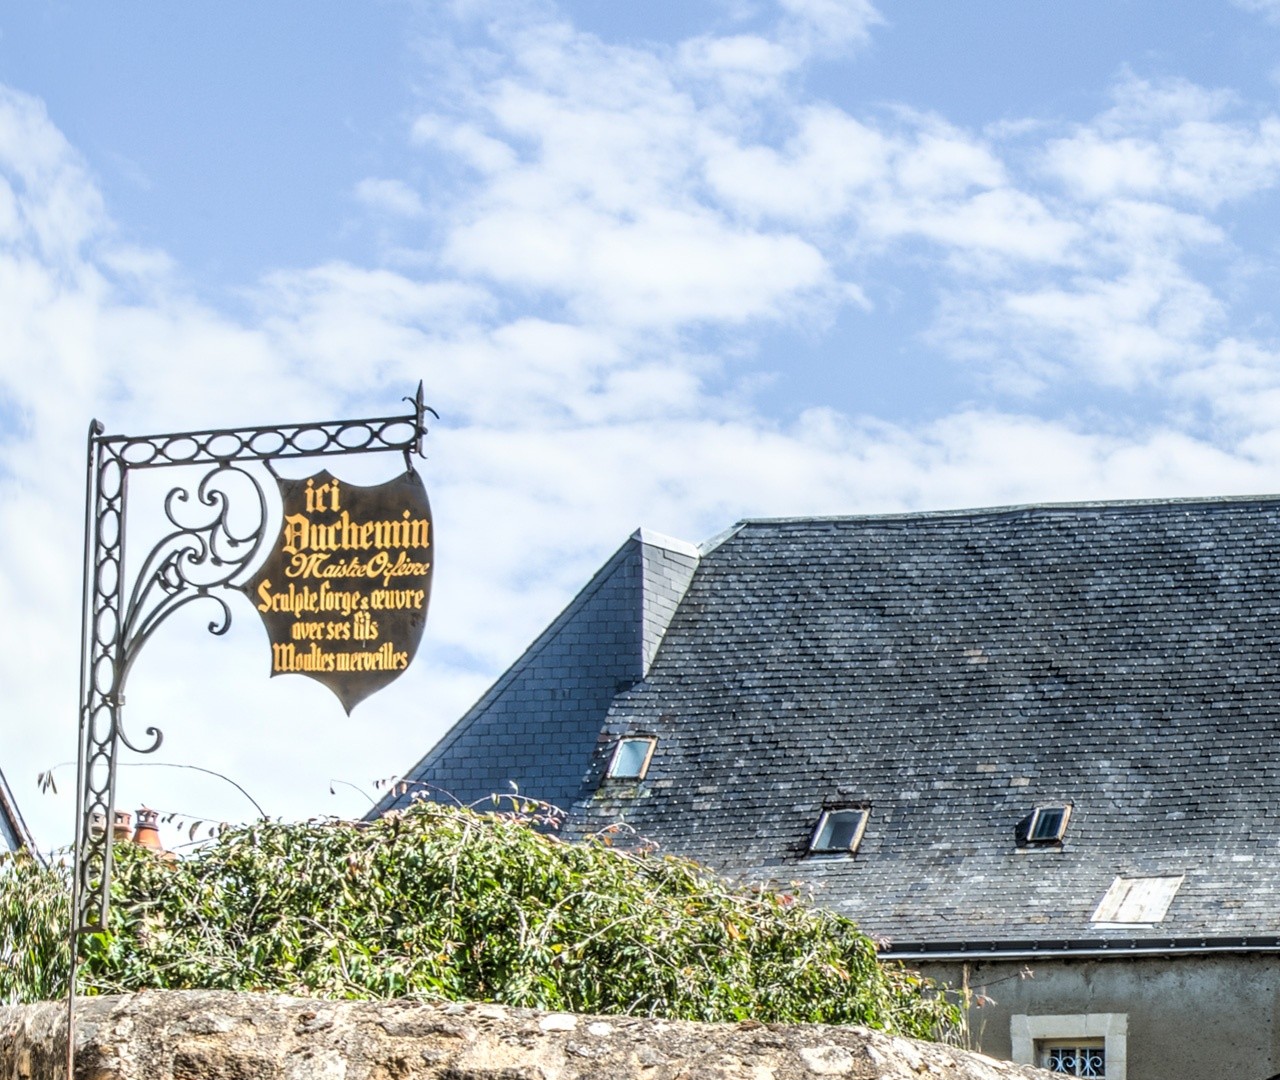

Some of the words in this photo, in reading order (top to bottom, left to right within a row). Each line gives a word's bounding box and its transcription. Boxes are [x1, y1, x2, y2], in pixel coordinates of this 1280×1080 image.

[305, 480, 340, 512] ici
[283, 510, 429, 556] Duchemin
[285, 553, 366, 578] Maistre
[320, 580, 360, 617] forge
[326, 622, 350, 640] ses
[354, 611, 378, 640] fils
[273, 642, 335, 671] Moultes
[336, 642, 407, 671] merveilles
